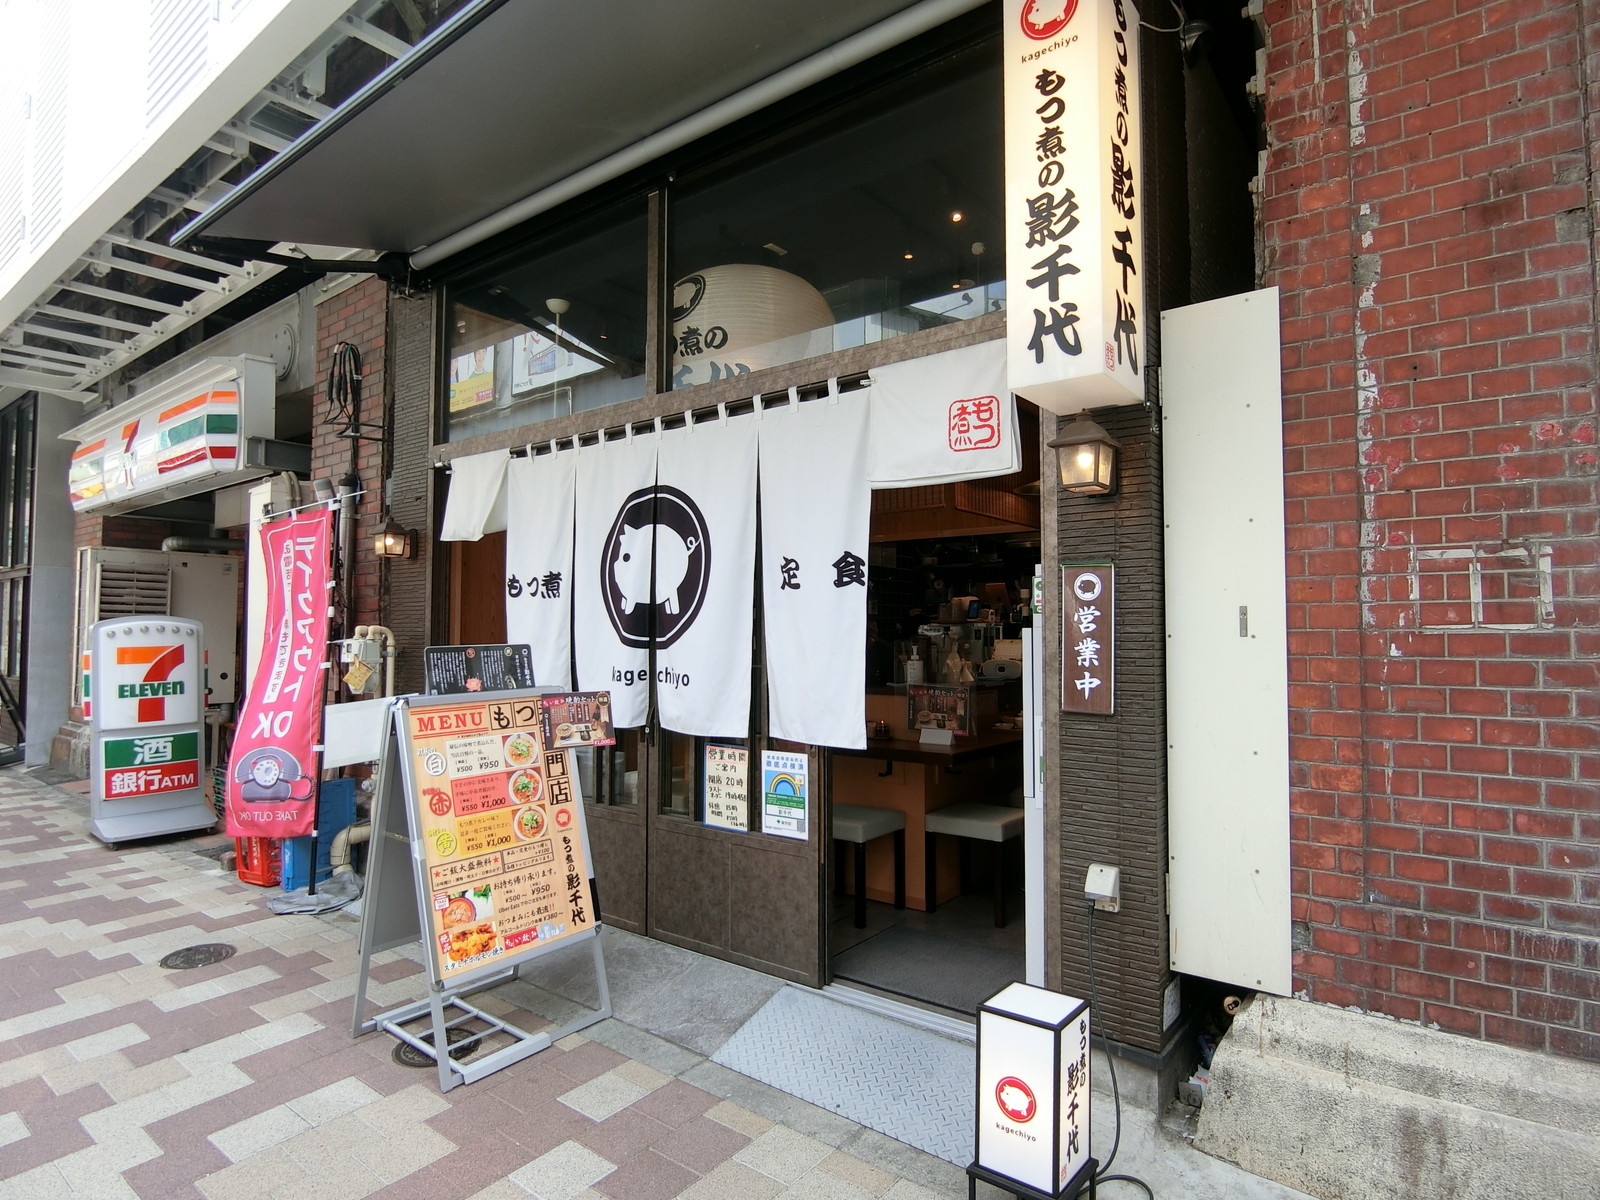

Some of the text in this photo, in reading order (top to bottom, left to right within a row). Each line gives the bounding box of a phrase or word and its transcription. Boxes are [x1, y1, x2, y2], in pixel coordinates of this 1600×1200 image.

[1021, 34, 1079, 64] kagechiyo
[1025, 68, 1082, 364] もつ煮の影千代
[673, 326, 729, 358] 煮の
[781, 551, 866, 591] 定食
[507, 571, 563, 599] もつ煮
[1073, 605, 1102, 700] 営業中
[417, 711, 483, 733] MENU
[133, 737, 174, 765] 酒
[708, 749, 747, 762] 営業時間
[456, 760, 499, 773] ¥500 ¥950
[111, 769, 195, 795] 銀行ATM
[461, 796, 506, 812] ¥550 ¥1,000
[466, 834, 511, 852] ¥550 ¥1,000
[442, 857, 493, 877] ご飯大盛無料
[493, 867, 557, 890] お持ち帰り承ります。
[531, 884, 551, 896] ¥950
[562, 836, 586, 927] もつ煮の影千代
[1079, 1018, 1087, 1087] もつ煮の
[1067, 1060, 1079, 1164] 影千代
[996, 1122, 1037, 1142] kagechiyo
